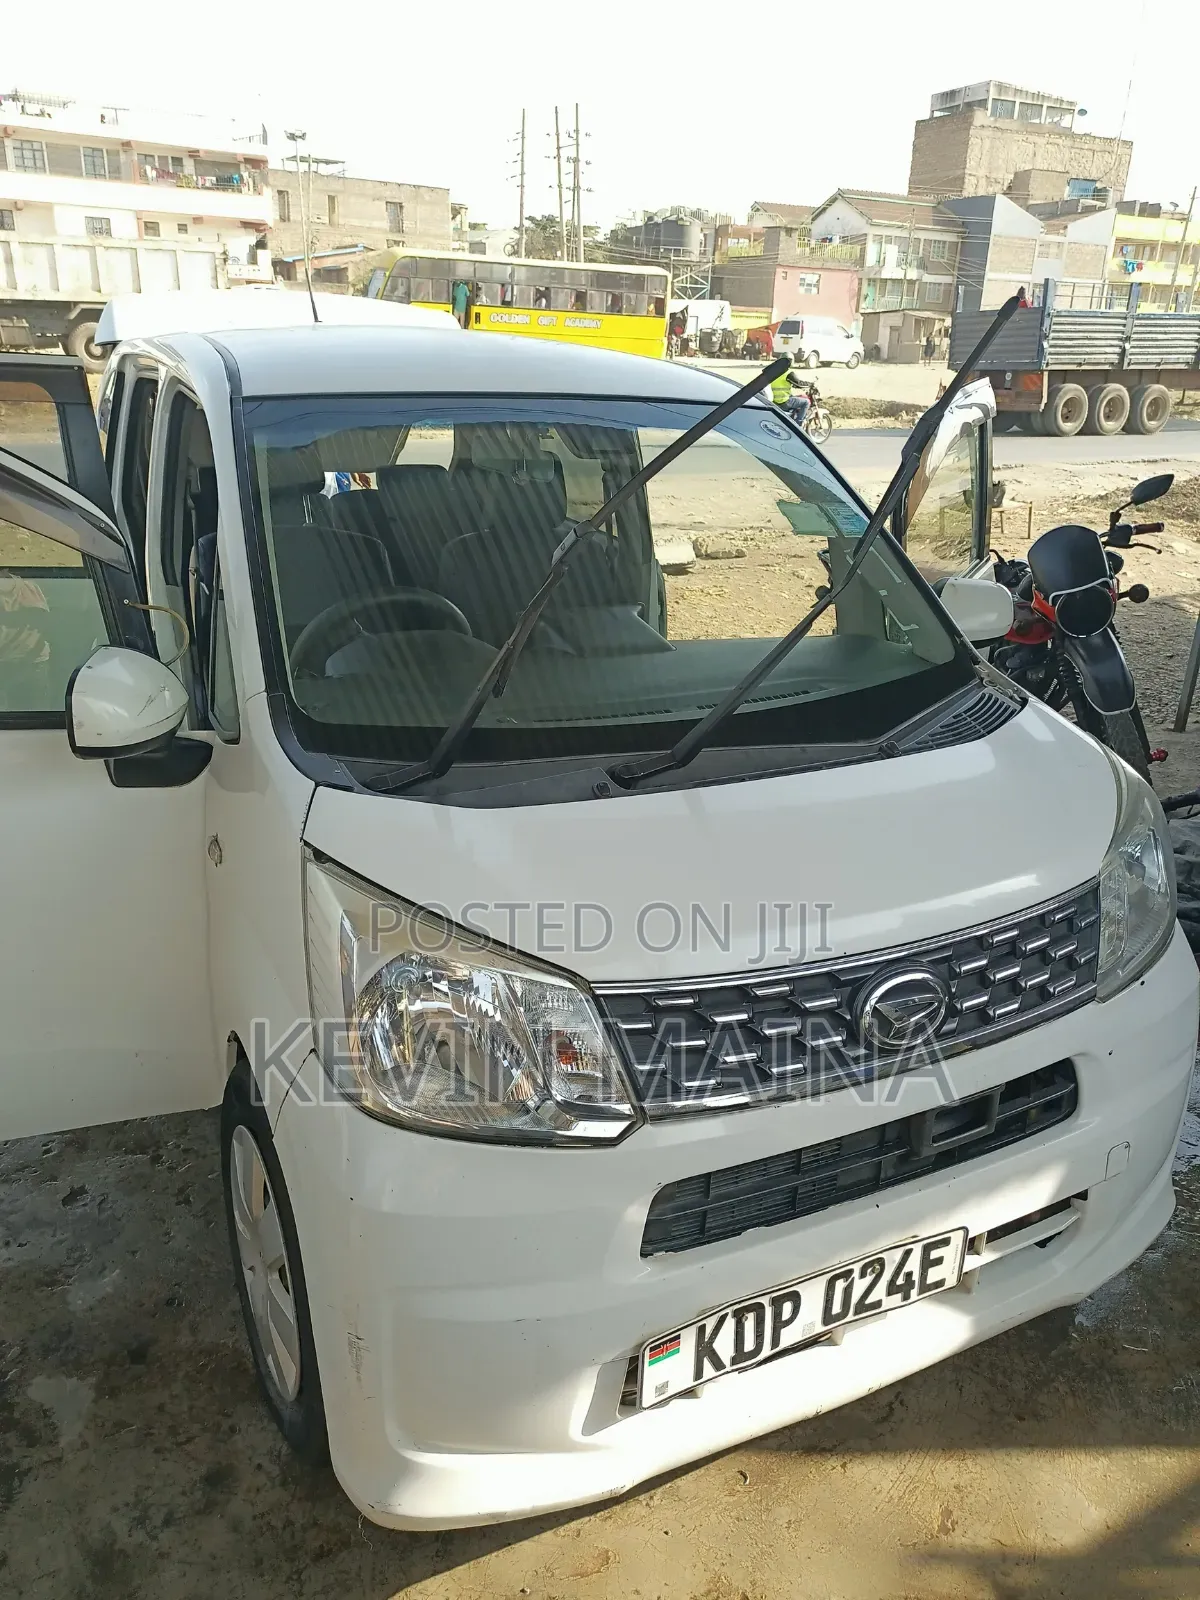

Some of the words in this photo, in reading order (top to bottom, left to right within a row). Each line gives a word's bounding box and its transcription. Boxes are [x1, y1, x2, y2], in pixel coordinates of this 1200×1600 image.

[490, 312, 530, 324] GOLDEN
[537, 315, 558, 327] GIFT
[564, 317, 603, 329] ACADEMY
[692, 1289, 801, 1382] KDP
[821, 1236, 952, 1328] 024E
